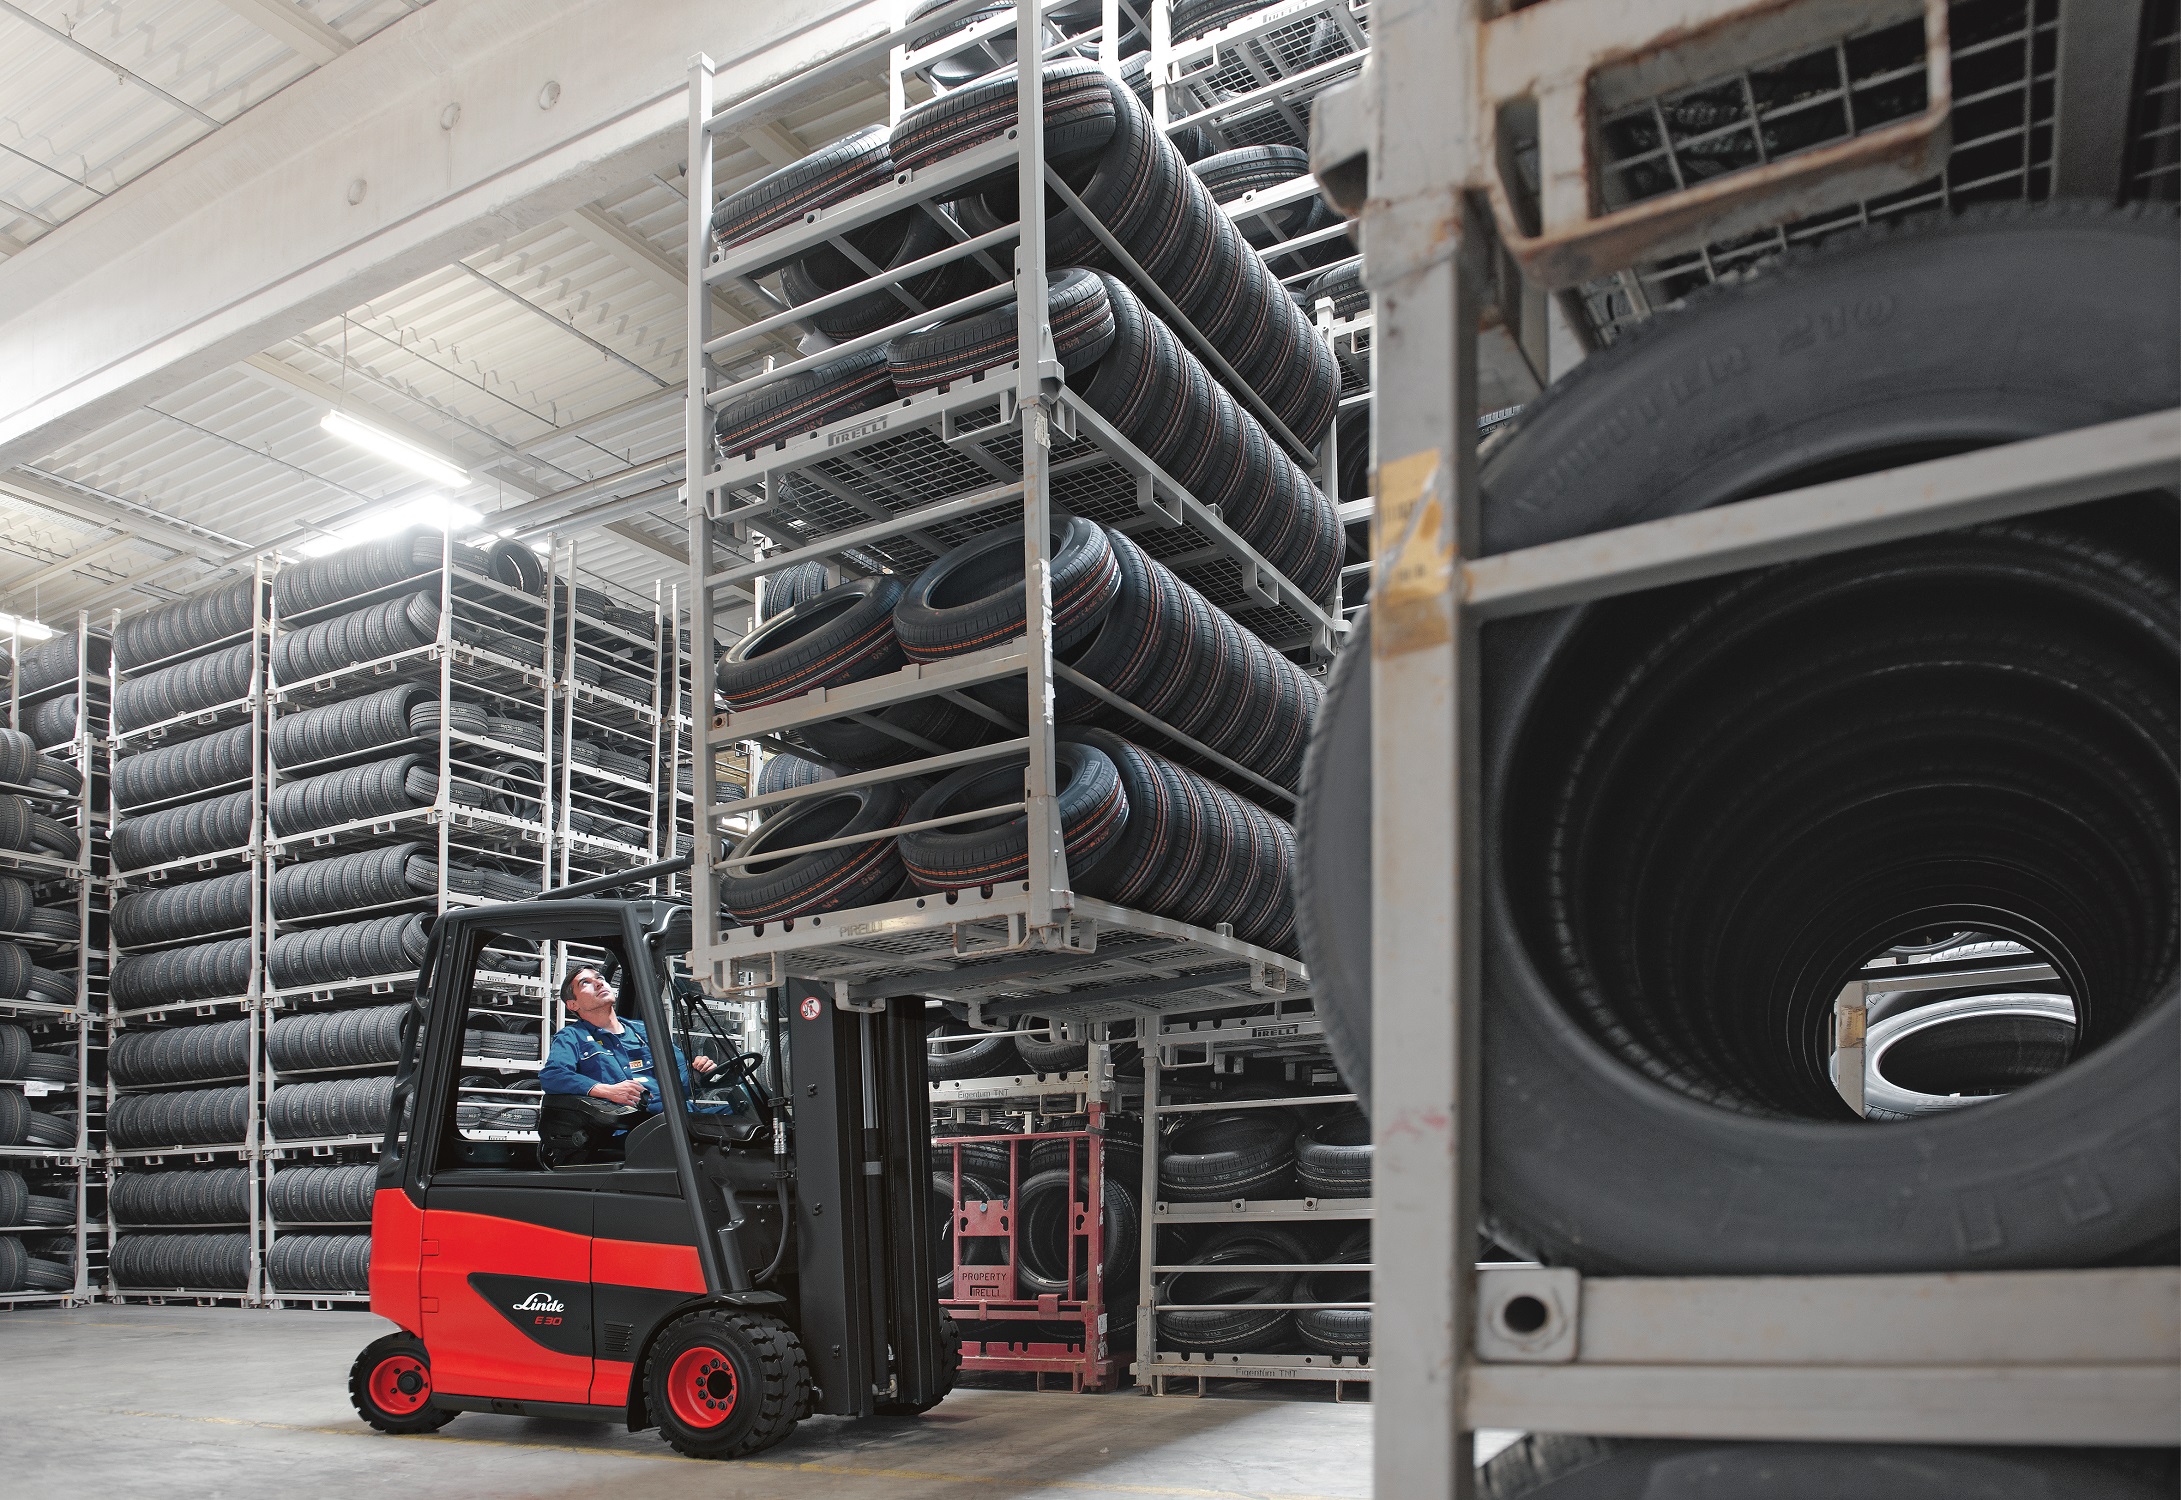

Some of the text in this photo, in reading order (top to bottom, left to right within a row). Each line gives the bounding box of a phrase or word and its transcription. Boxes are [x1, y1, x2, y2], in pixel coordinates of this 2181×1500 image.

[828, 415, 888, 447] PIRELLI
[840, 920, 883, 937] PIRELLI
[1252, 1024, 1299, 1037] PIRELLI
[993, 1088, 1009, 1097] TNT
[962, 1272, 1007, 1281] PROPERTY
[970, 1285, 1000, 1297] PIRELLI
[512, 1292, 565, 1312] Linde
[534, 1316, 563, 1326] E 30
[1279, 1369, 1298, 1377] TNT
